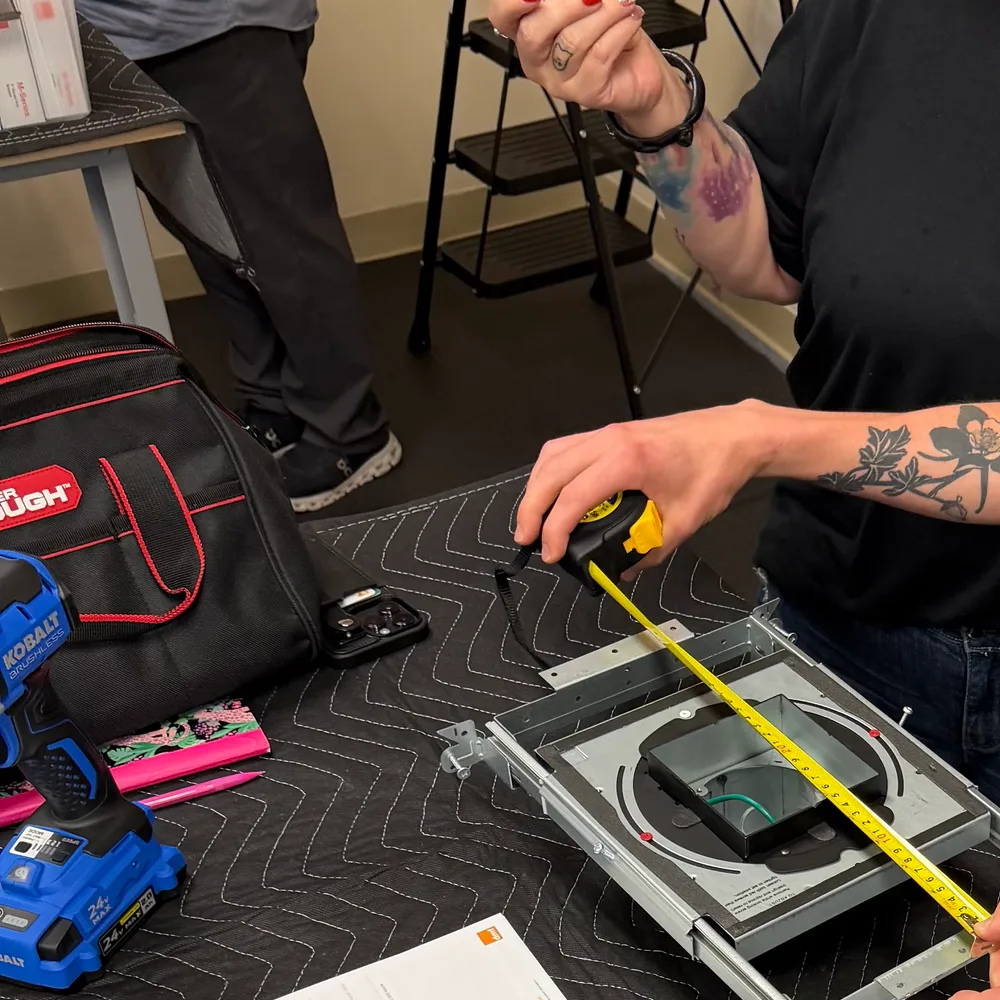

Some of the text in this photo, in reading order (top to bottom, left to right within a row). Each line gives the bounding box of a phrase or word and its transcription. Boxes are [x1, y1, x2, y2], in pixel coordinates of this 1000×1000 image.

[2, 610, 59, 671] KOBALT
[9, 628, 65, 680] BRUSHLESS
[92, 903, 112, 926] MAX
[125, 909, 142, 930] MAX
[486, 927, 503, 941] dmf
